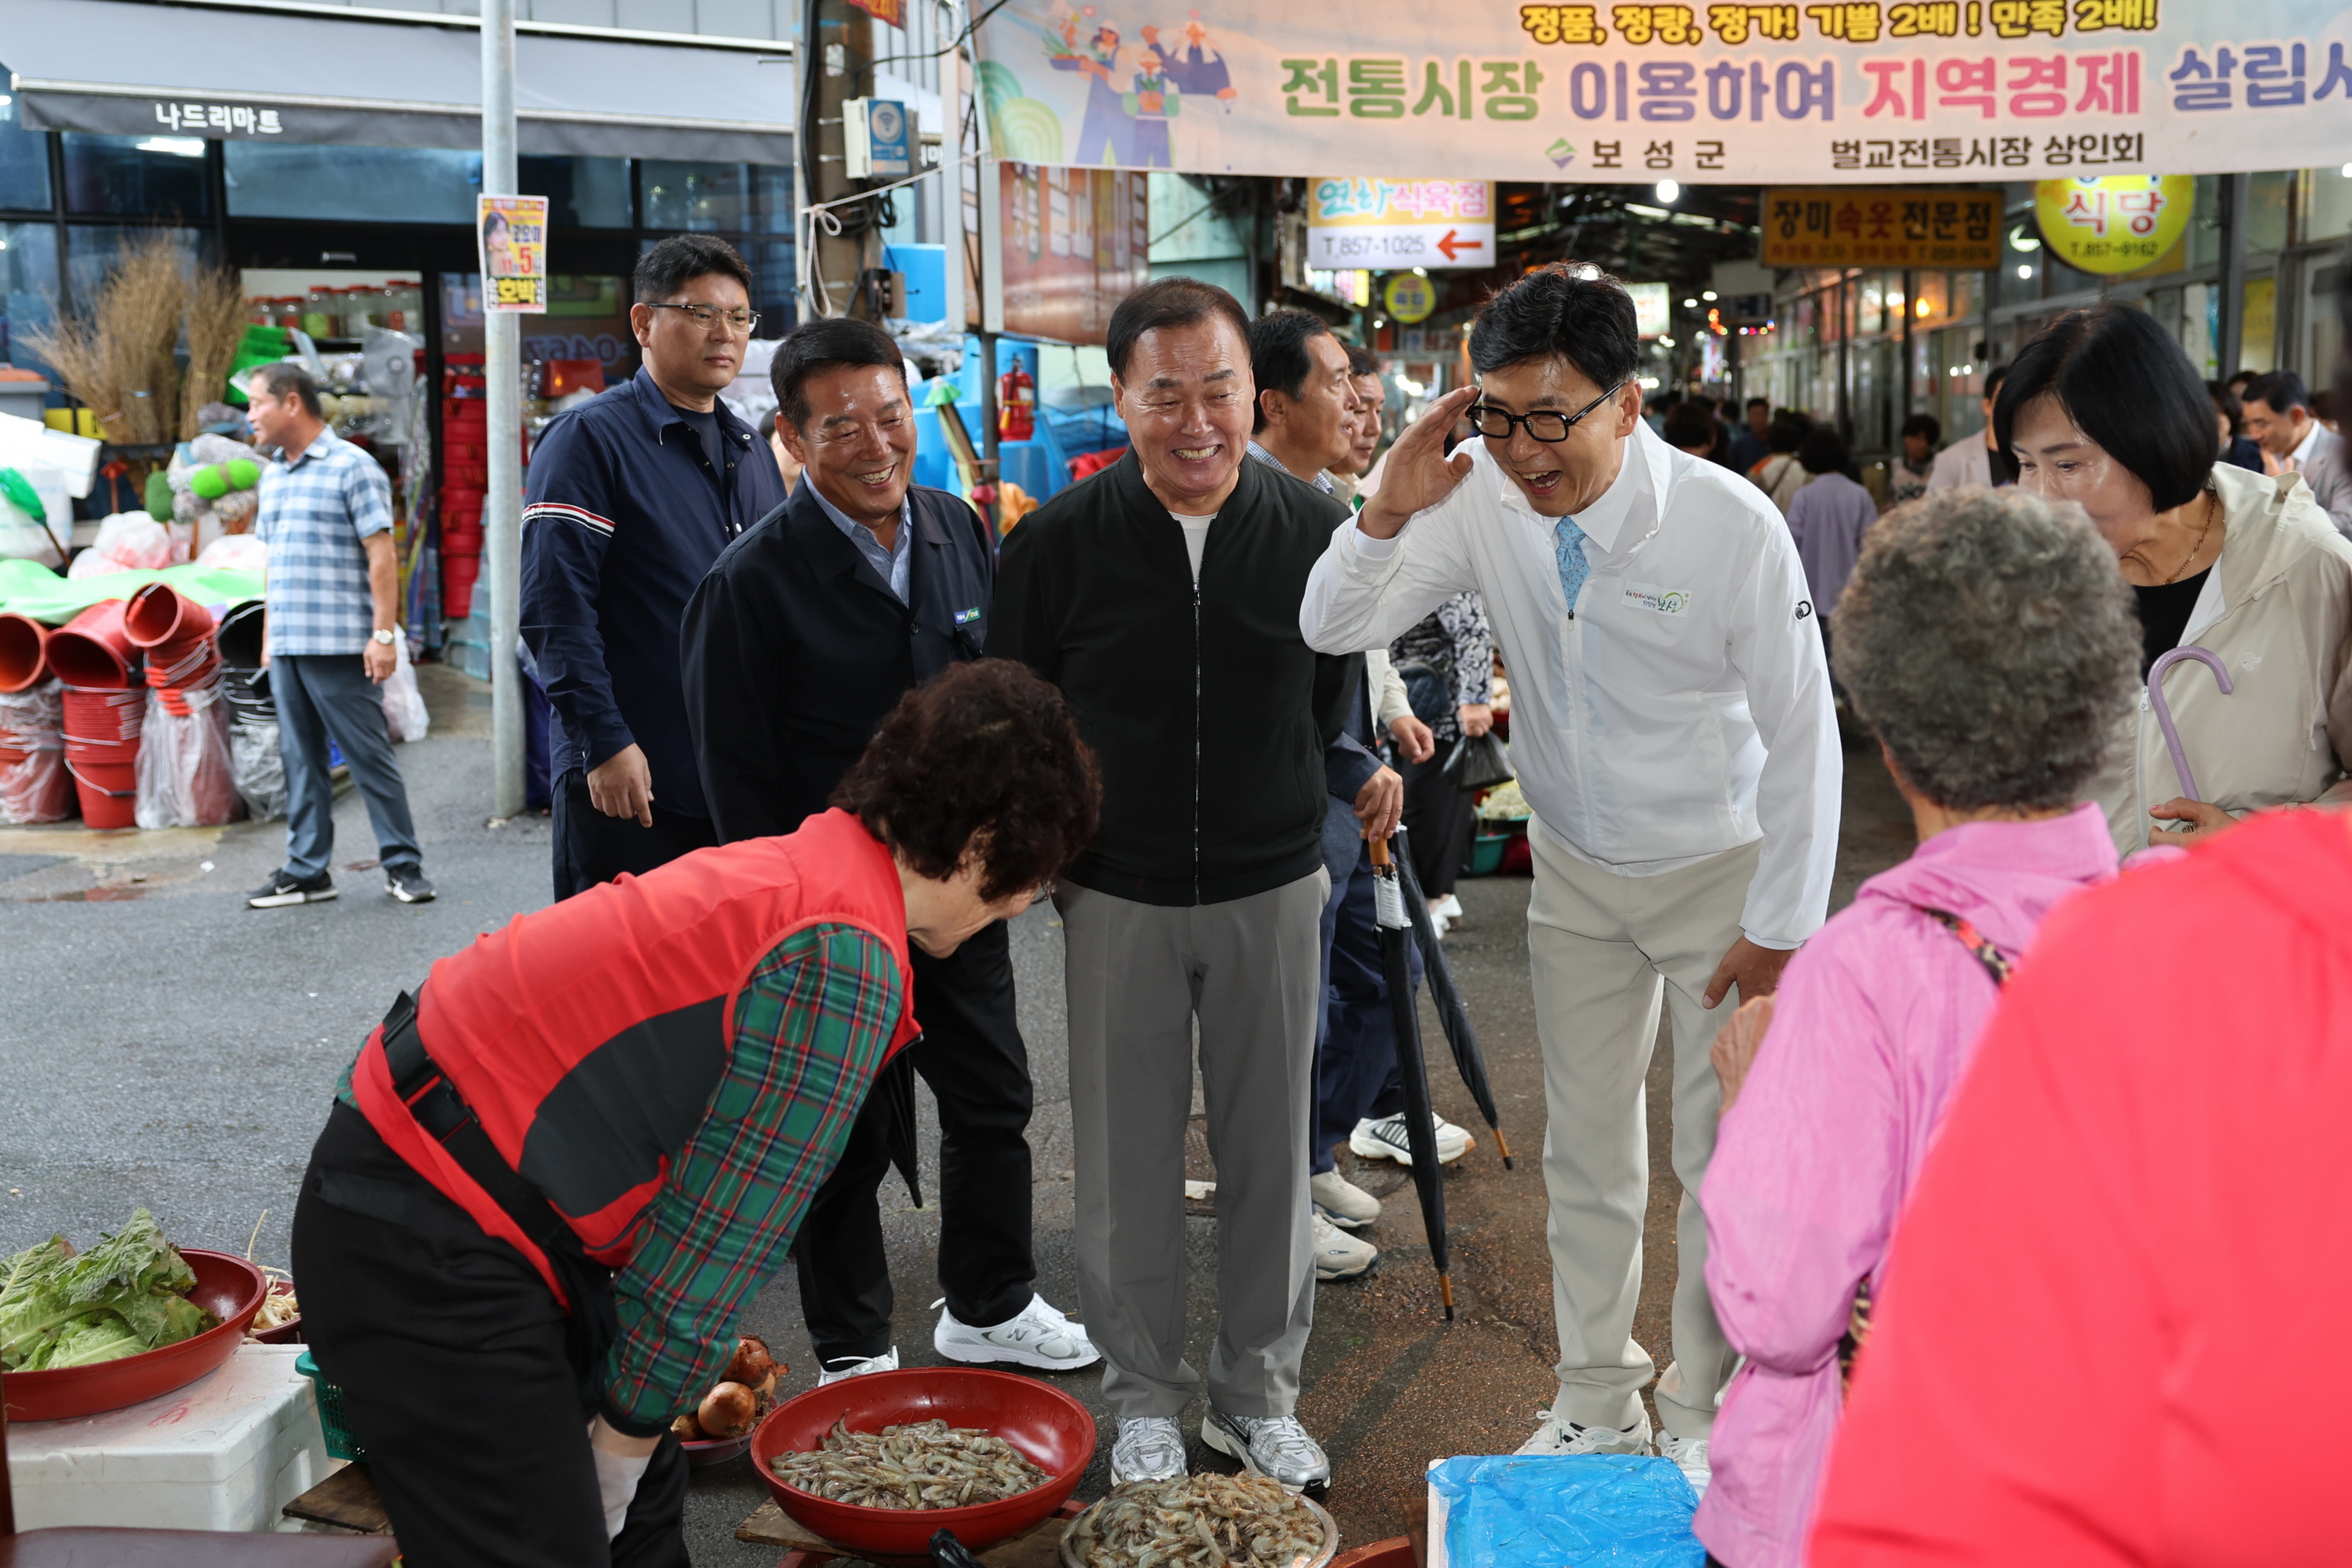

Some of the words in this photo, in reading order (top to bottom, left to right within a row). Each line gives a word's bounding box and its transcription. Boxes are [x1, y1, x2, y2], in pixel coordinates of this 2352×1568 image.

[1520, 4, 1608, 45] 정품,
[1611, 4, 1704, 45] 정량,
[1707, 3, 1799, 45] 정가!
[1805, 2, 1882, 42] 기쁨
[1990, 0, 2067, 38] 만족
[2074, 0, 2158, 32] 2배!
[1281, 57, 1545, 122] 전통시장
[1570, 60, 1836, 122] 이용하여
[1862, 51, 2141, 121] 지역경제
[154, 102, 284, 136] 나드리마트
[1831, 136, 2033, 170] 벌교전통시장
[2043, 132, 2144, 165] 상인회
[2063, 189, 2166, 238] 식당
